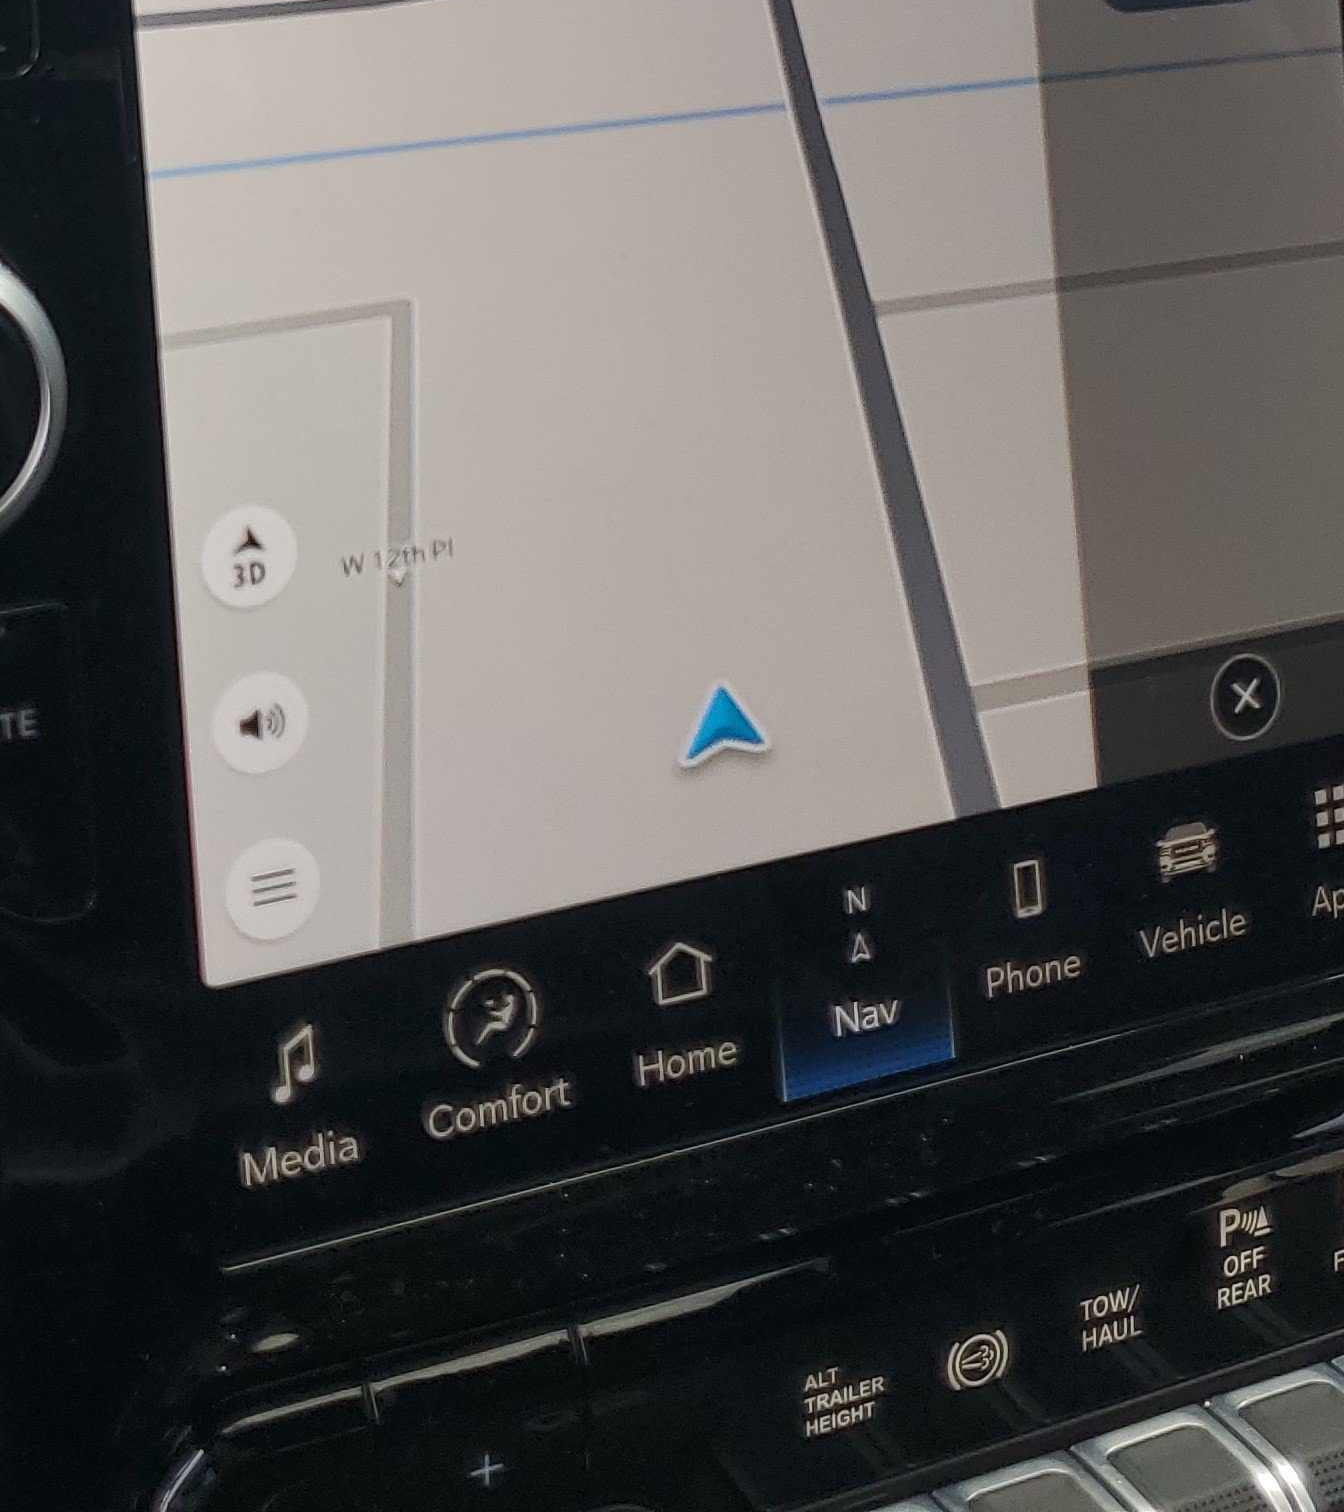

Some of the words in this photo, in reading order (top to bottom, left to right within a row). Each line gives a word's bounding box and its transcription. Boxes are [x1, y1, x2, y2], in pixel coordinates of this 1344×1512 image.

[232, 559, 267, 587] 3D
[341, 552, 364, 577] W
[374, 546, 426, 570] 12th
[432, 537, 453, 560] Pl
[844, 888, 866, 914] N
[1139, 906, 1246, 959] Vehicle
[987, 951, 1082, 997] Phone
[833, 998, 898, 1037] Nav
[633, 1038, 738, 1088] Home
[427, 1076, 570, 1139] Comfort
[239, 1133, 360, 1187] Media
[1223, 1247, 1264, 1276] OFF
[1079, 1284, 1140, 1322] TOW/
[1217, 1275, 1272, 1309] REAR
[1082, 1316, 1141, 1350] HAUL
[804, 1375, 885, 1413] TRAILER
[805, 1368, 839, 1392] ALT
[805, 1402, 876, 1436] HEIGHT
